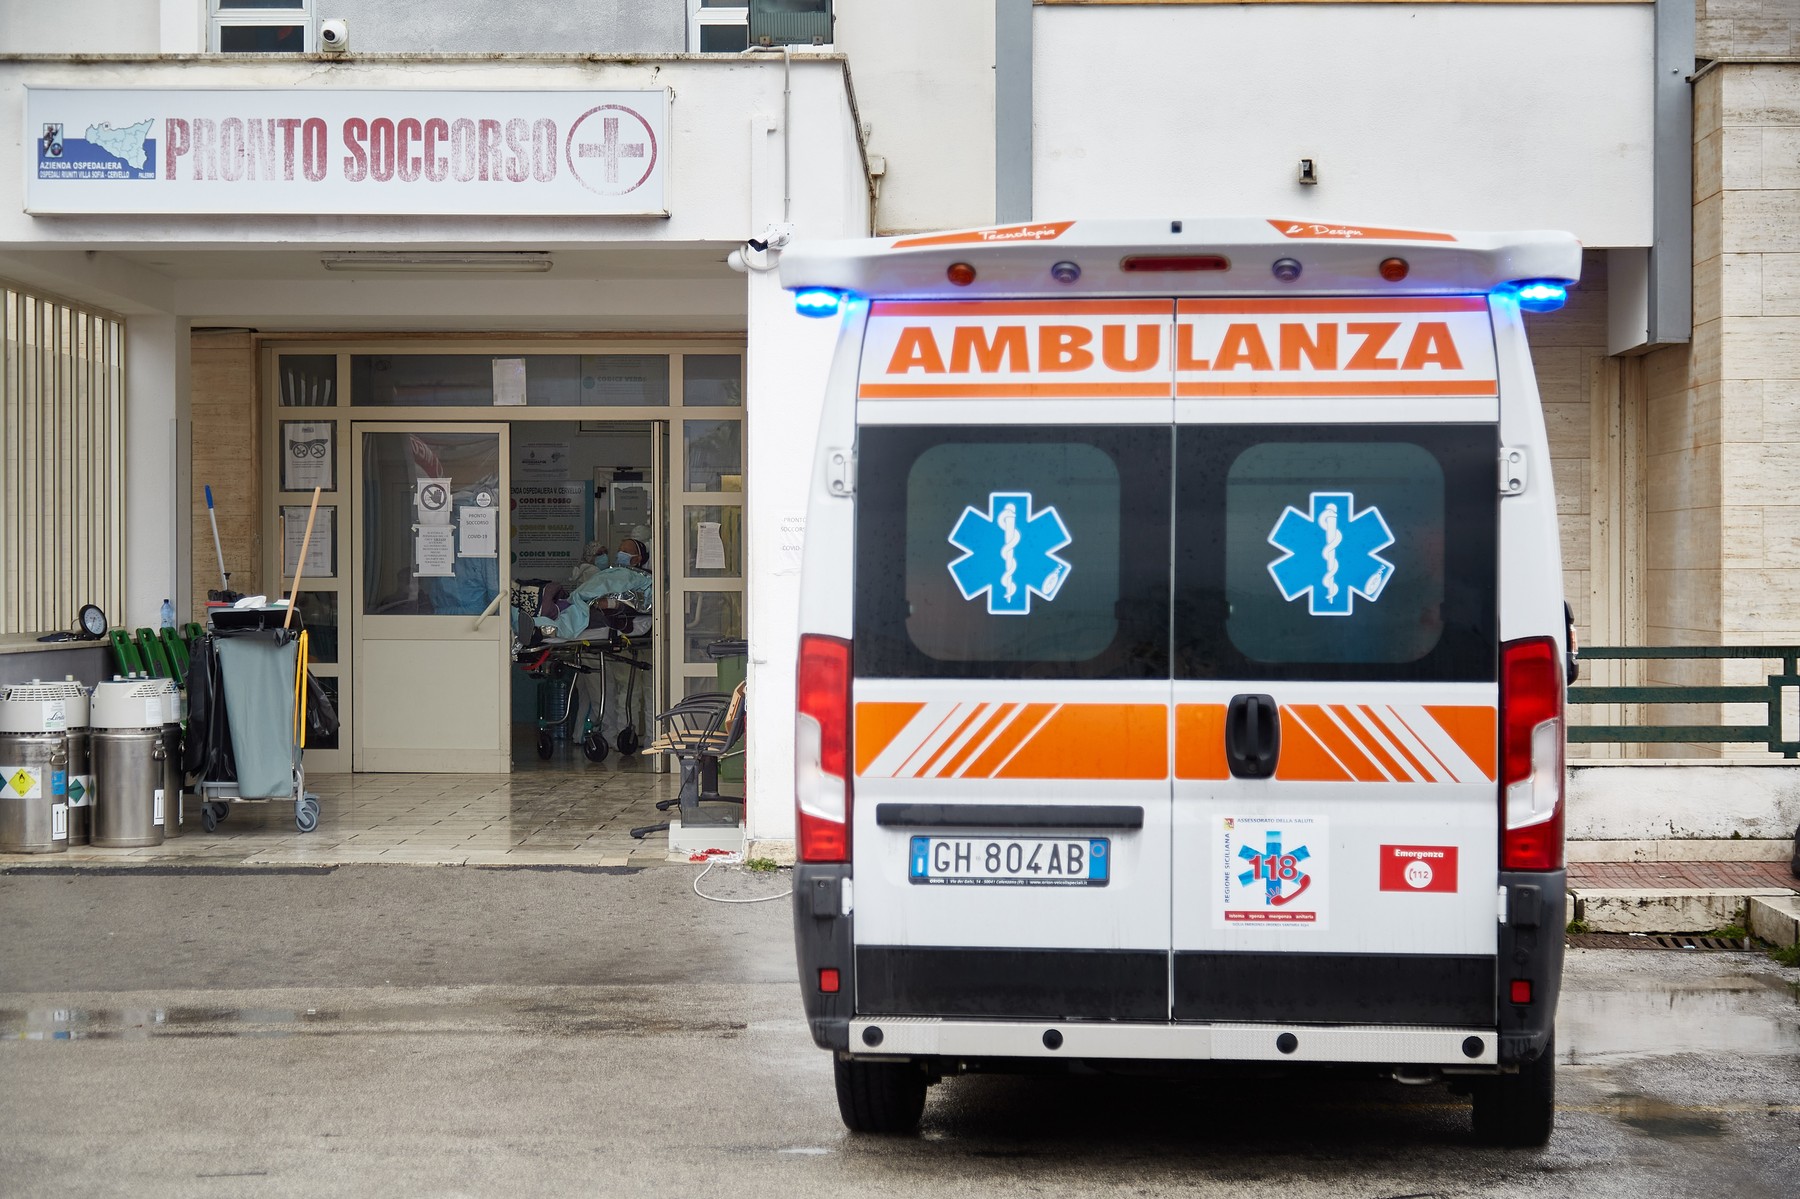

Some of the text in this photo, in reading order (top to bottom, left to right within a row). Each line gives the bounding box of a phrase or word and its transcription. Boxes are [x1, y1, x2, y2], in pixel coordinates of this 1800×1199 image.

[166, 117, 557, 183] PRONTO SOCCORSO
[978, 226, 1055, 240] Tecnologia
[1309, 225, 1363, 237] Design
[886, 322, 1463, 374] AMBULANZA
[934, 842, 1084, 875] GH 804AB
[1395, 849, 1444, 859] Emergenza
[1248, 855, 1298, 880] 118
[1413, 870, 1429, 879] 112
